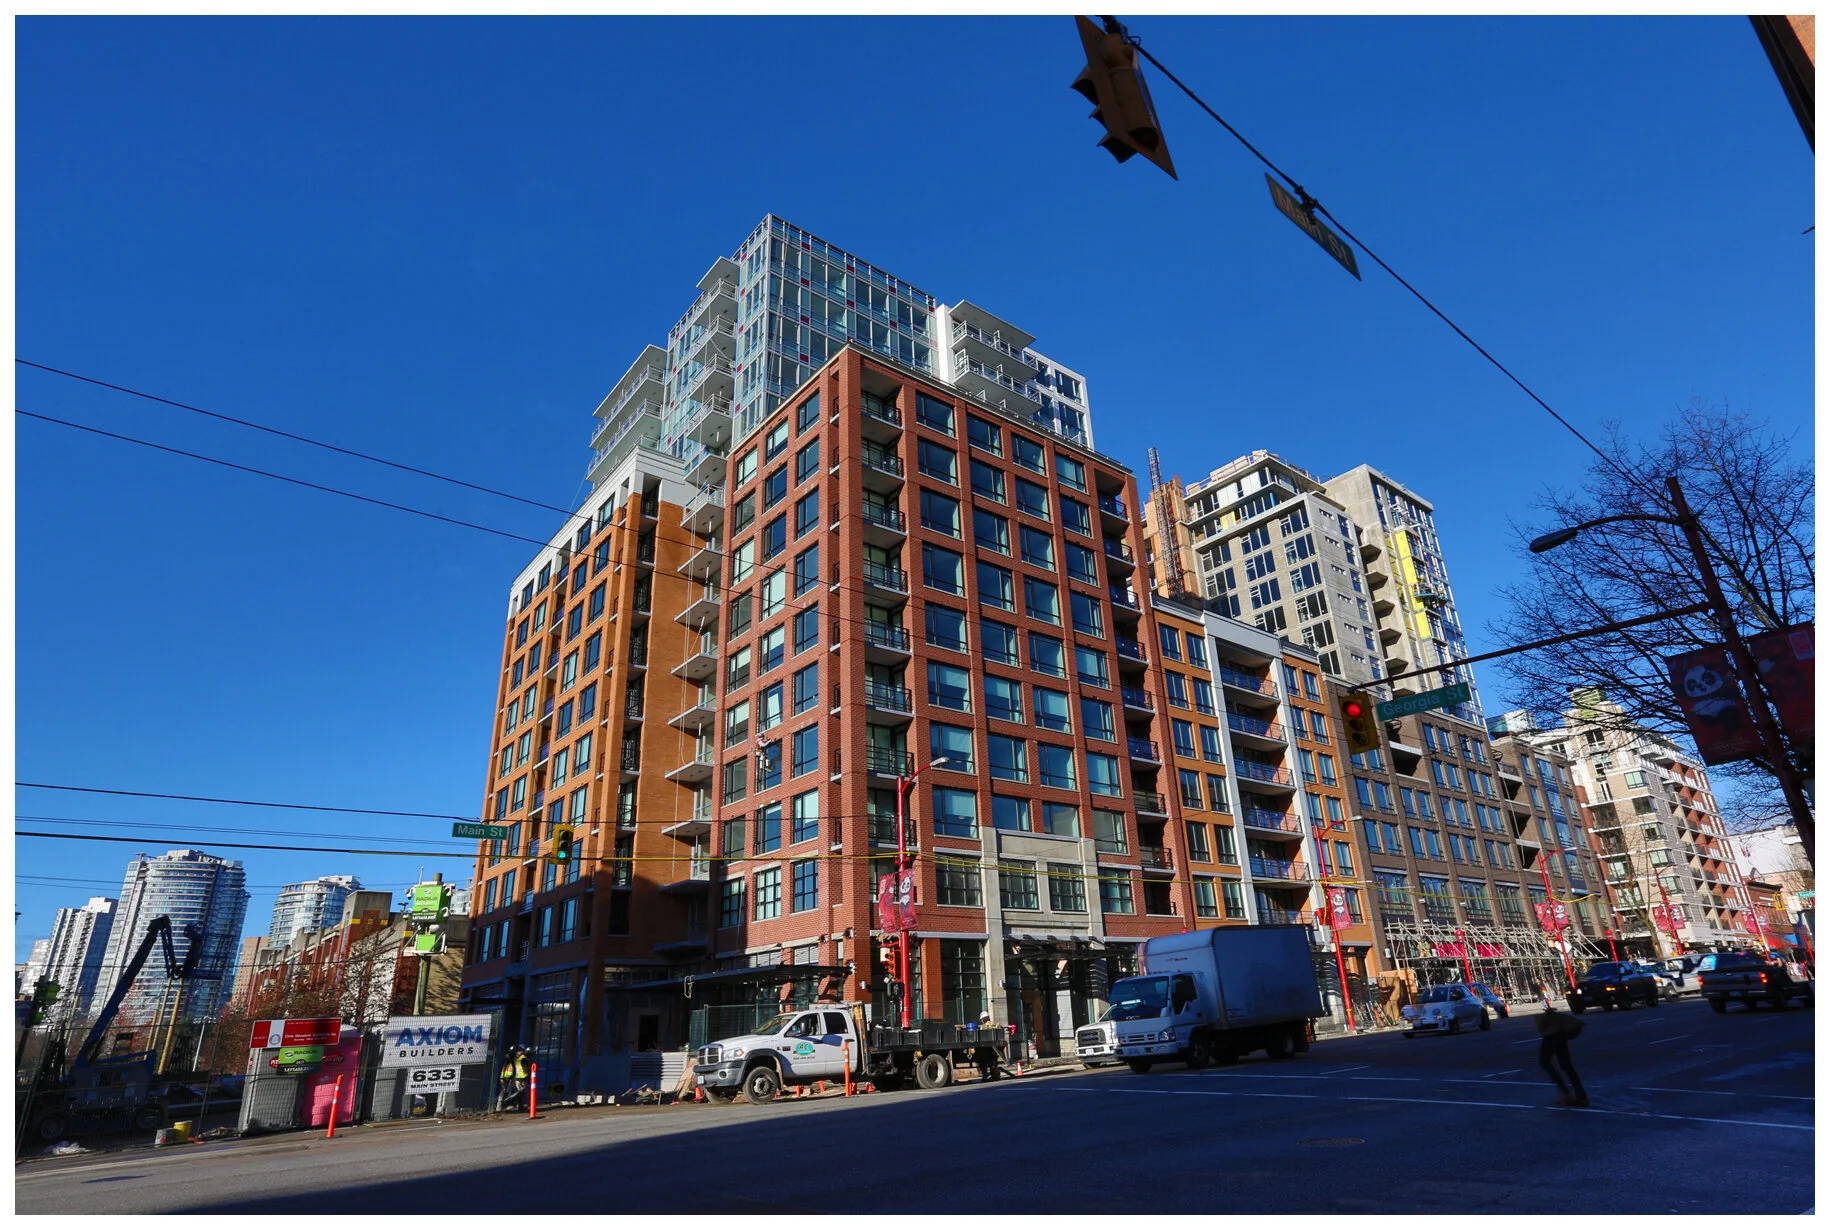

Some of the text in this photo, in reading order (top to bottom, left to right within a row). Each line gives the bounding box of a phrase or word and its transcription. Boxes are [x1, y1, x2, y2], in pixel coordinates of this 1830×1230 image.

[1383, 686, 1464, 716] Georgia St
[457, 825, 503, 837] Main St
[394, 1025, 483, 1047] AXIOM
[399, 1046, 474, 1057] BUILDERS
[412, 1068, 456, 1082] 633
